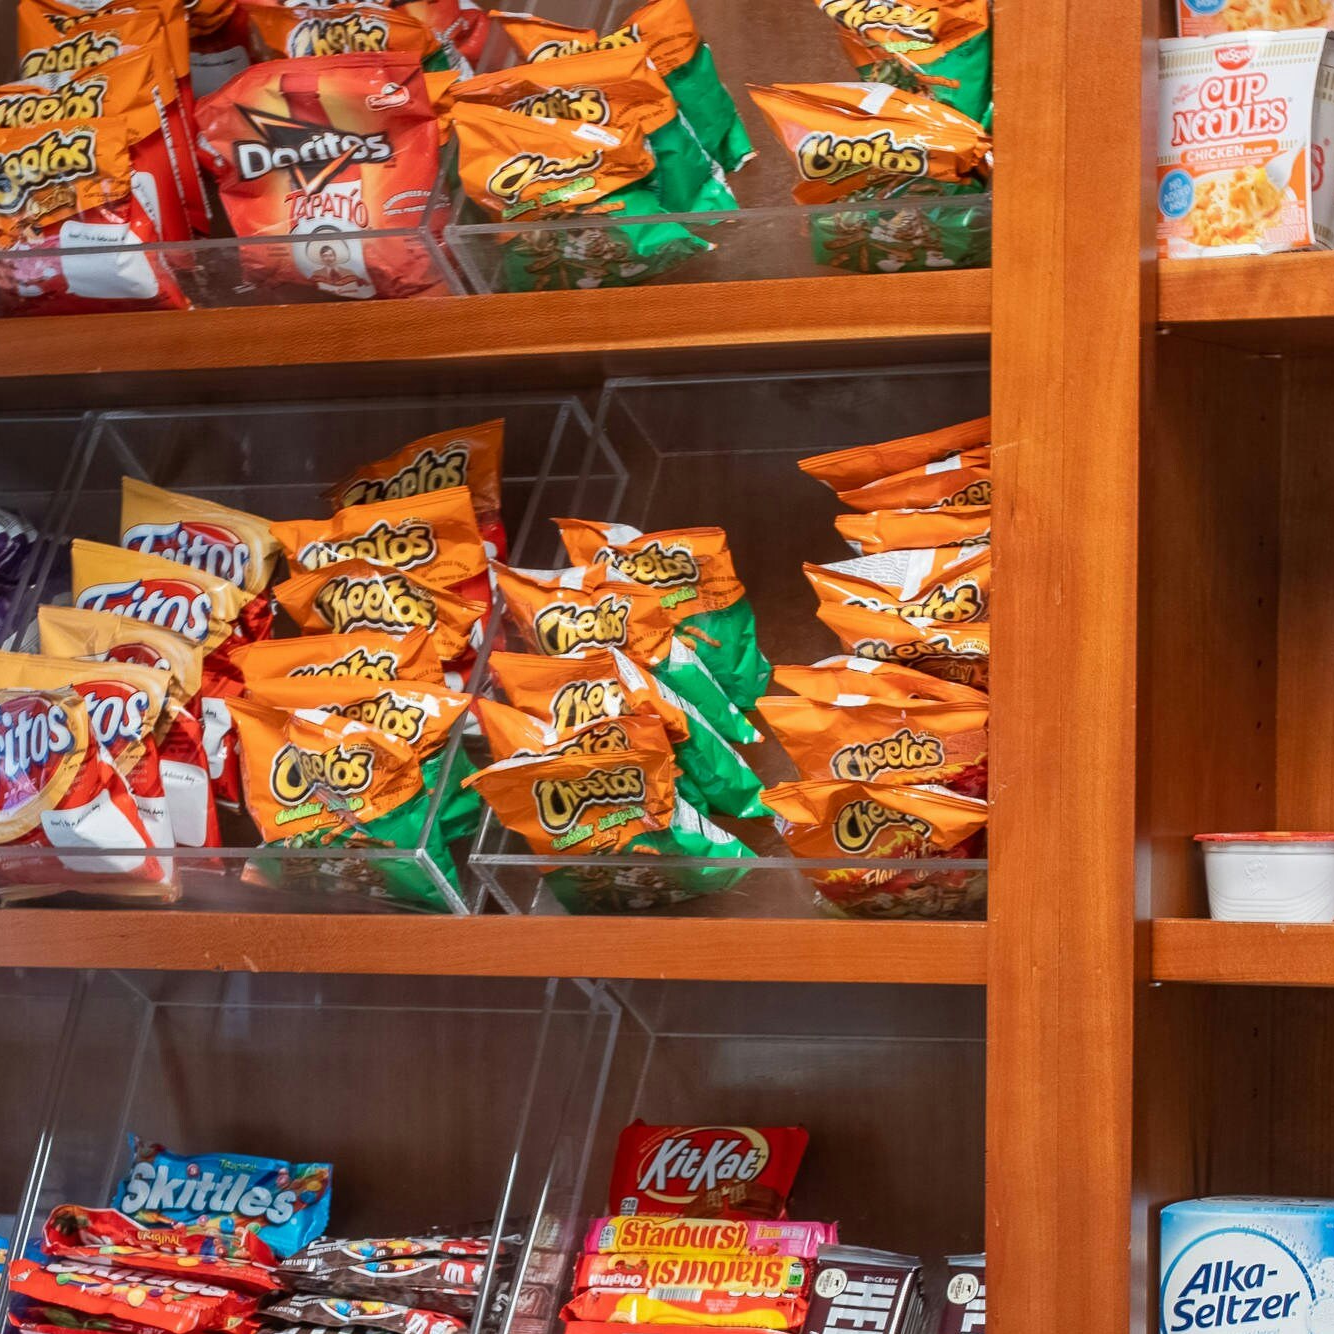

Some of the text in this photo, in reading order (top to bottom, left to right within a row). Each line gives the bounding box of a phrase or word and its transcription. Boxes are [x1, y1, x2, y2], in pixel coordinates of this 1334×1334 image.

[1199, 72, 1268, 107] CUP
[1172, 97, 1287, 147] NOODLES
[237, 131, 392, 181] Doritos
[1188, 145, 1243, 161] CHICKEN
[833, 728, 944, 780] Cheetos
[534, 766, 645, 832] Cheetos
[122, 1162, 297, 1223] Skittles
[621, 1220, 746, 1248] Starburst
[1179, 1261, 1277, 1297] Alka-
[1171, 1291, 1299, 1332] Seltzer
